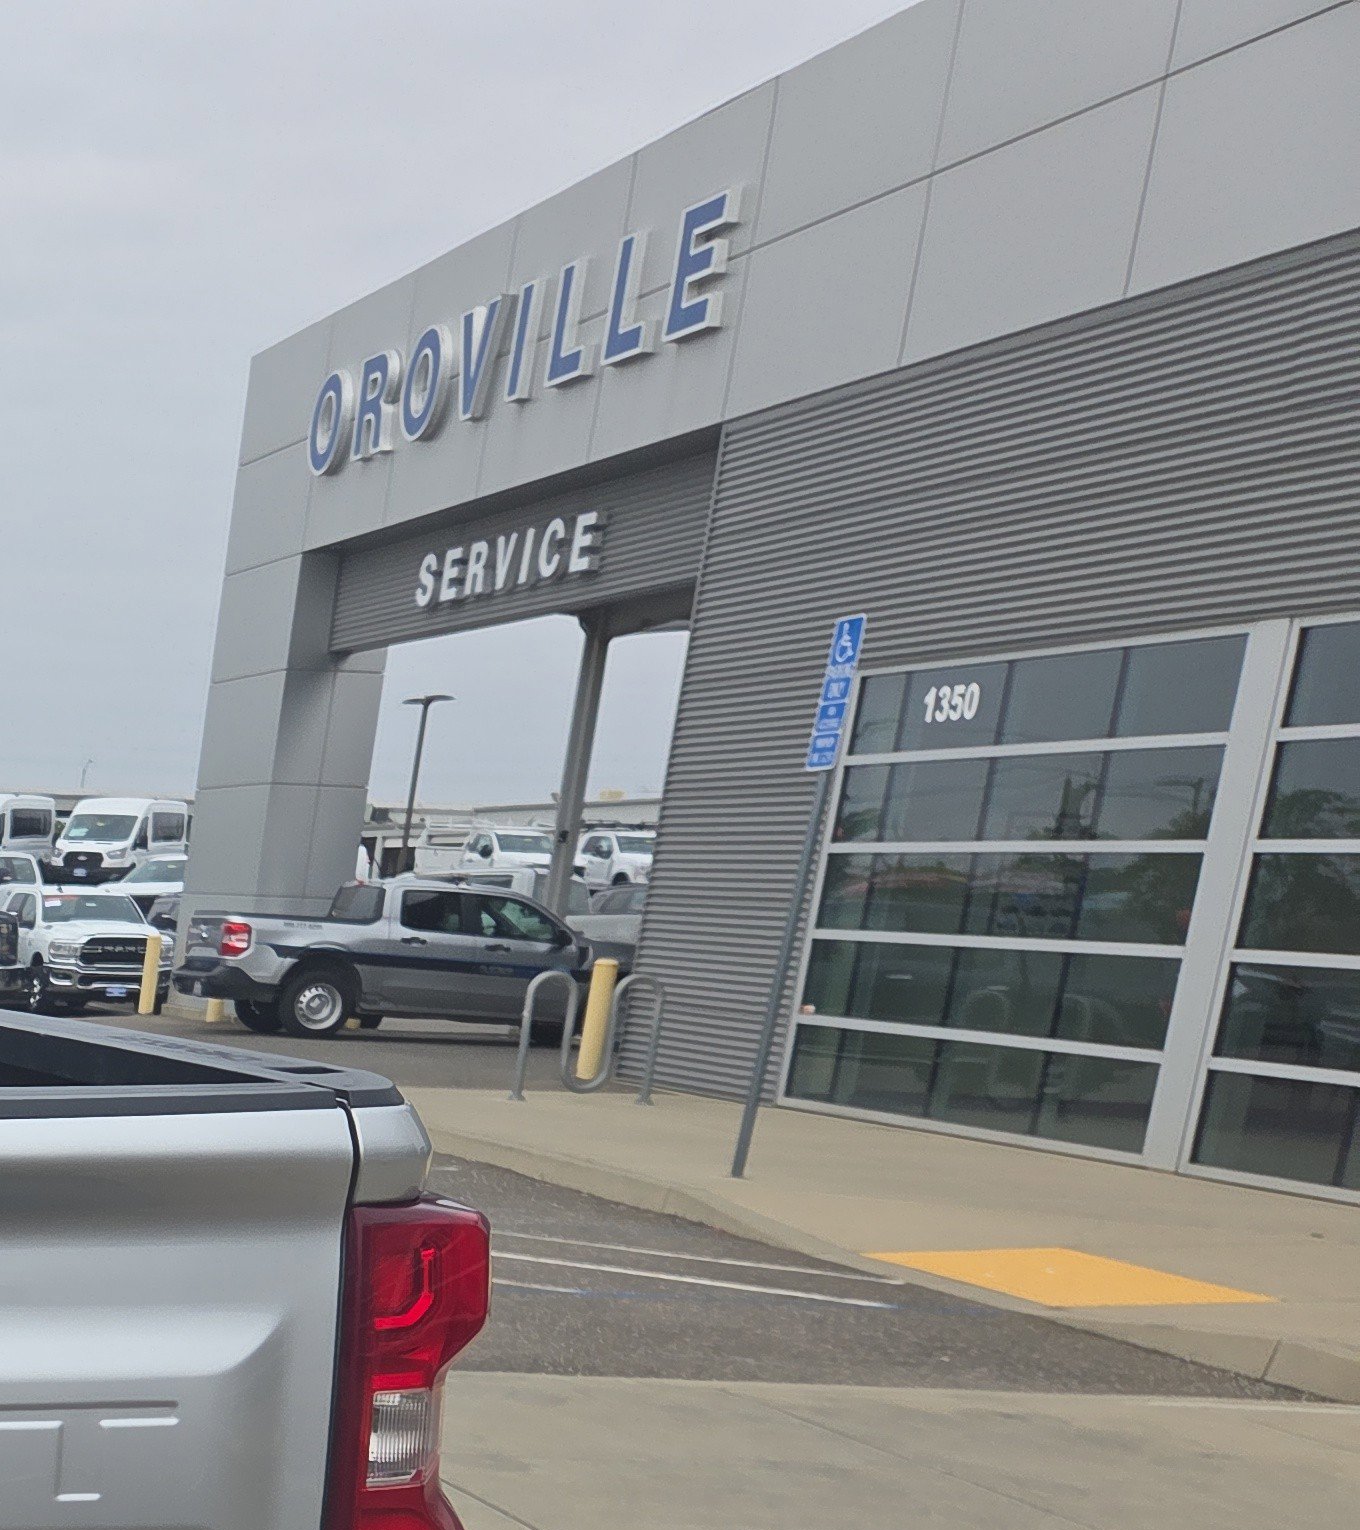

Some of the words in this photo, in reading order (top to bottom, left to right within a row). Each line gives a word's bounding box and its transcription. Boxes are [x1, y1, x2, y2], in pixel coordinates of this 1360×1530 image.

[307, 188, 739, 476] OROVILLE
[415, 511, 600, 608] SERVICE
[923, 682, 981, 724] 1350
